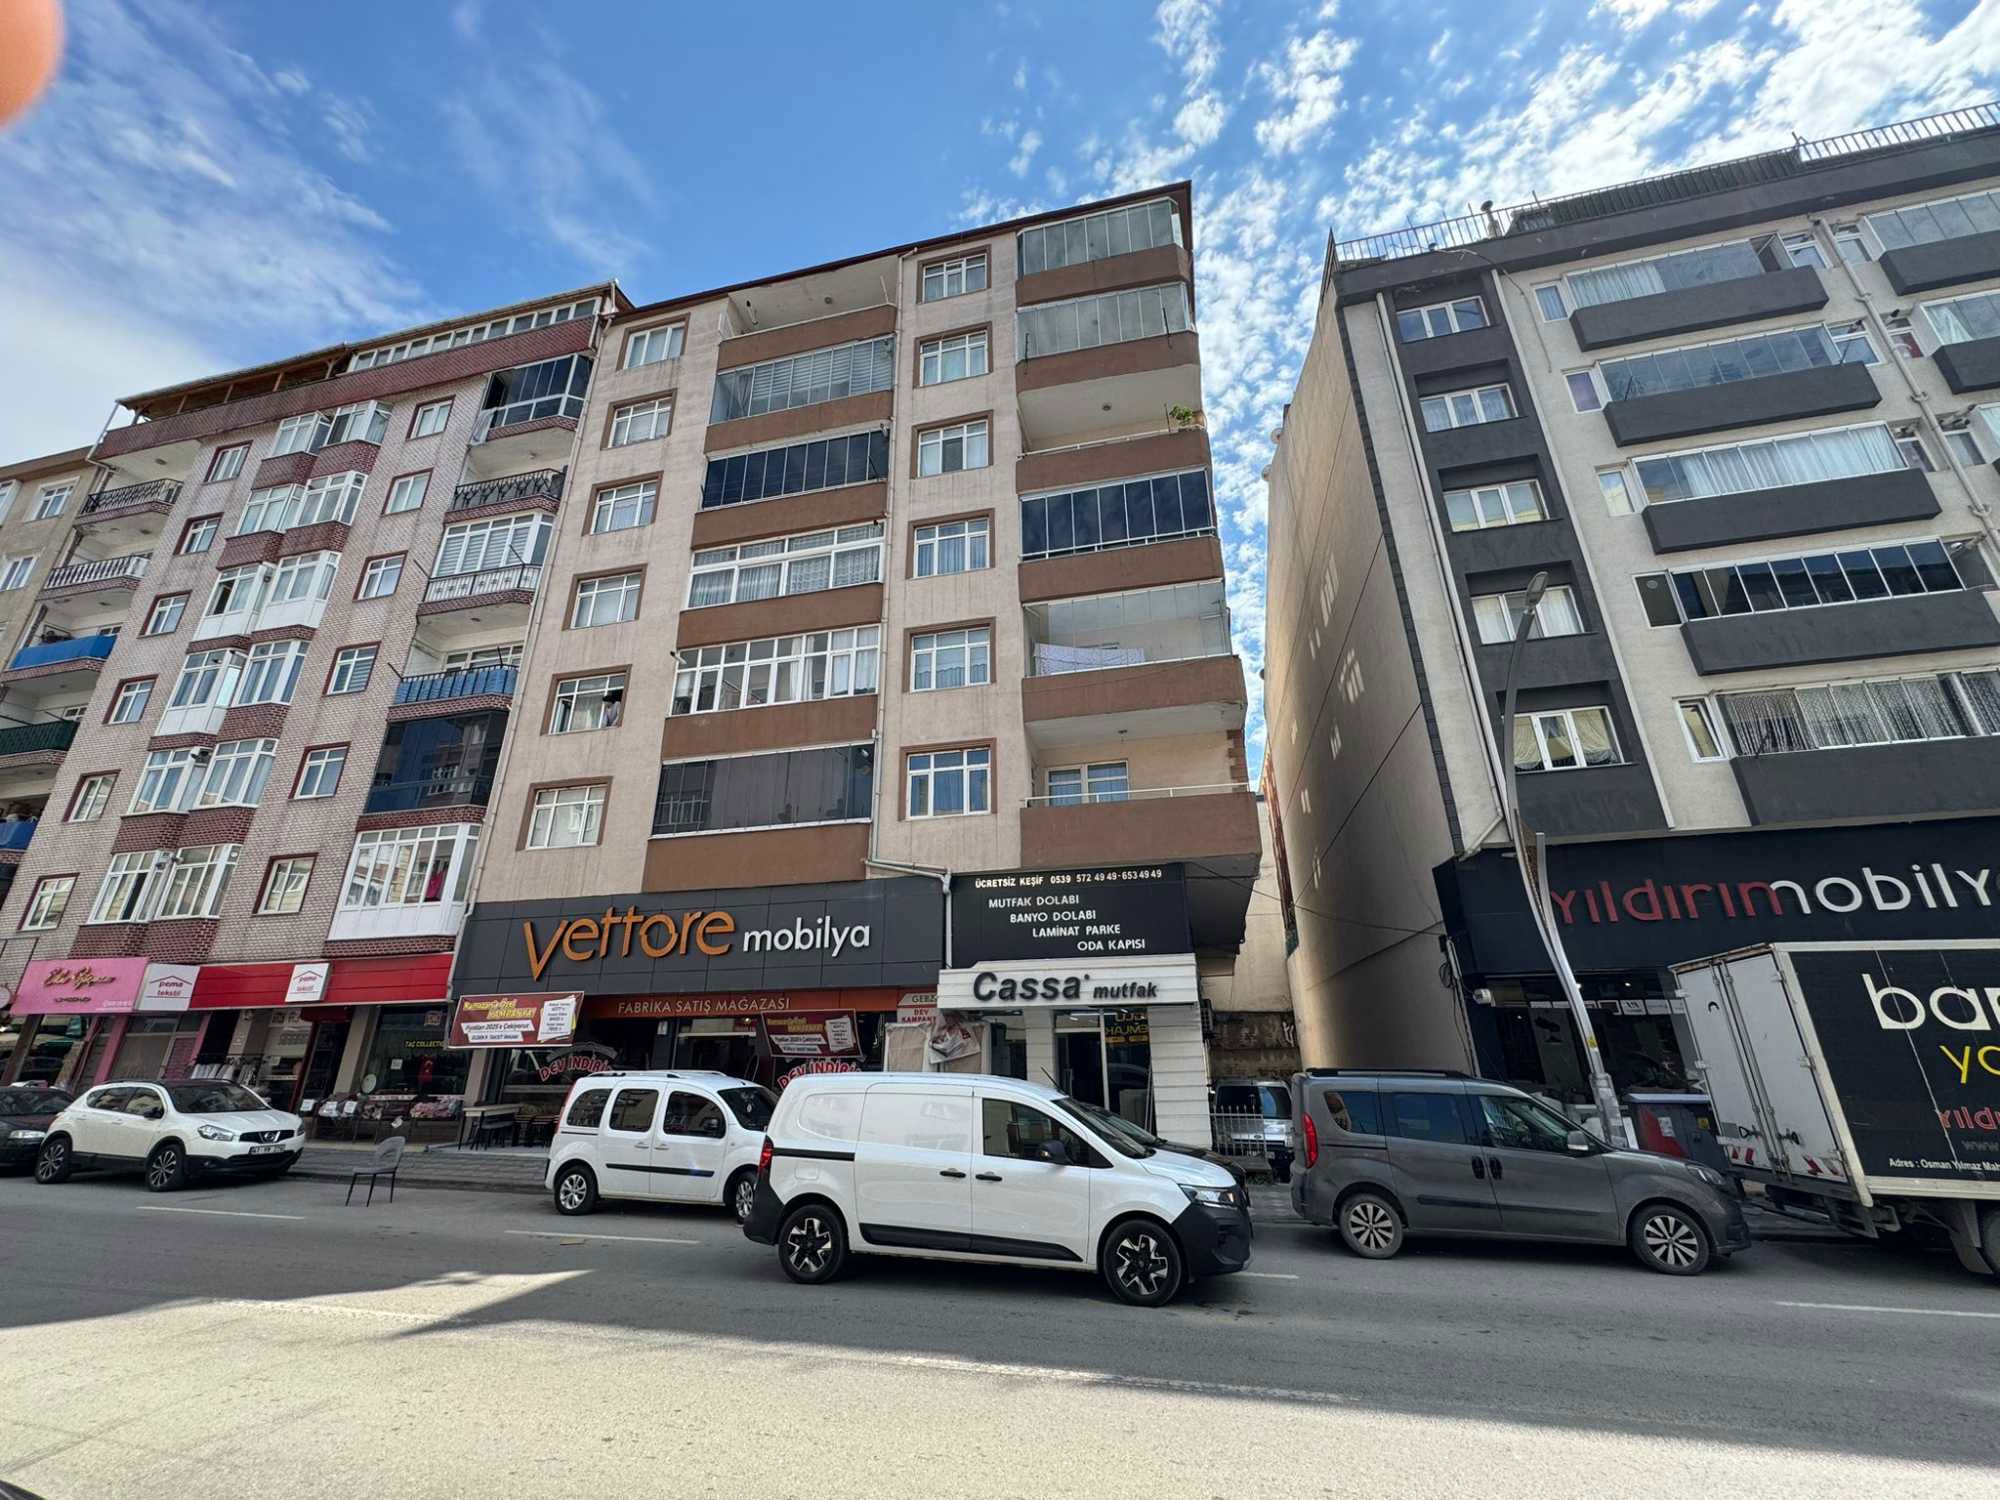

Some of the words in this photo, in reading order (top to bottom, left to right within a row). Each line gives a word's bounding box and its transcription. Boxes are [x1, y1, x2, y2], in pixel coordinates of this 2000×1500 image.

[975, 876, 1016, 888] ÜCRETSİZ
[1020, 875, 1044, 887] KEŞİF
[1050, 875, 1071, 884] 0539
[1076, 873, 1092, 882] 572
[988, 896, 1032, 909] MUTFAK
[1036, 894, 1079, 906] DOLABI
[1010, 912, 1048, 923] BANYO
[1052, 909, 1096, 921] DOLABI
[1032, 925, 1080, 938] LAMİNAT
[1085, 923, 1120, 935] PARKE
[522, 904, 736, 983] Vettore
[743, 914, 872, 958] mobilya
[1077, 941, 1104, 951] ODA
[1108, 938, 1146, 950] KAPISI
[972, 971, 1082, 1001] Cassa
[1092, 981, 1158, 999] mutfak
[676, 999, 711, 1015] SATIŞ
[715, 996, 790, 1012] MAĞAZASI
[540, 1058, 566, 1082] DEV
[777, 1063, 806, 1090] DEV
[1889, 1158, 1914, 1168] Adres
[1920, 1158, 1952, 1169] Osman
